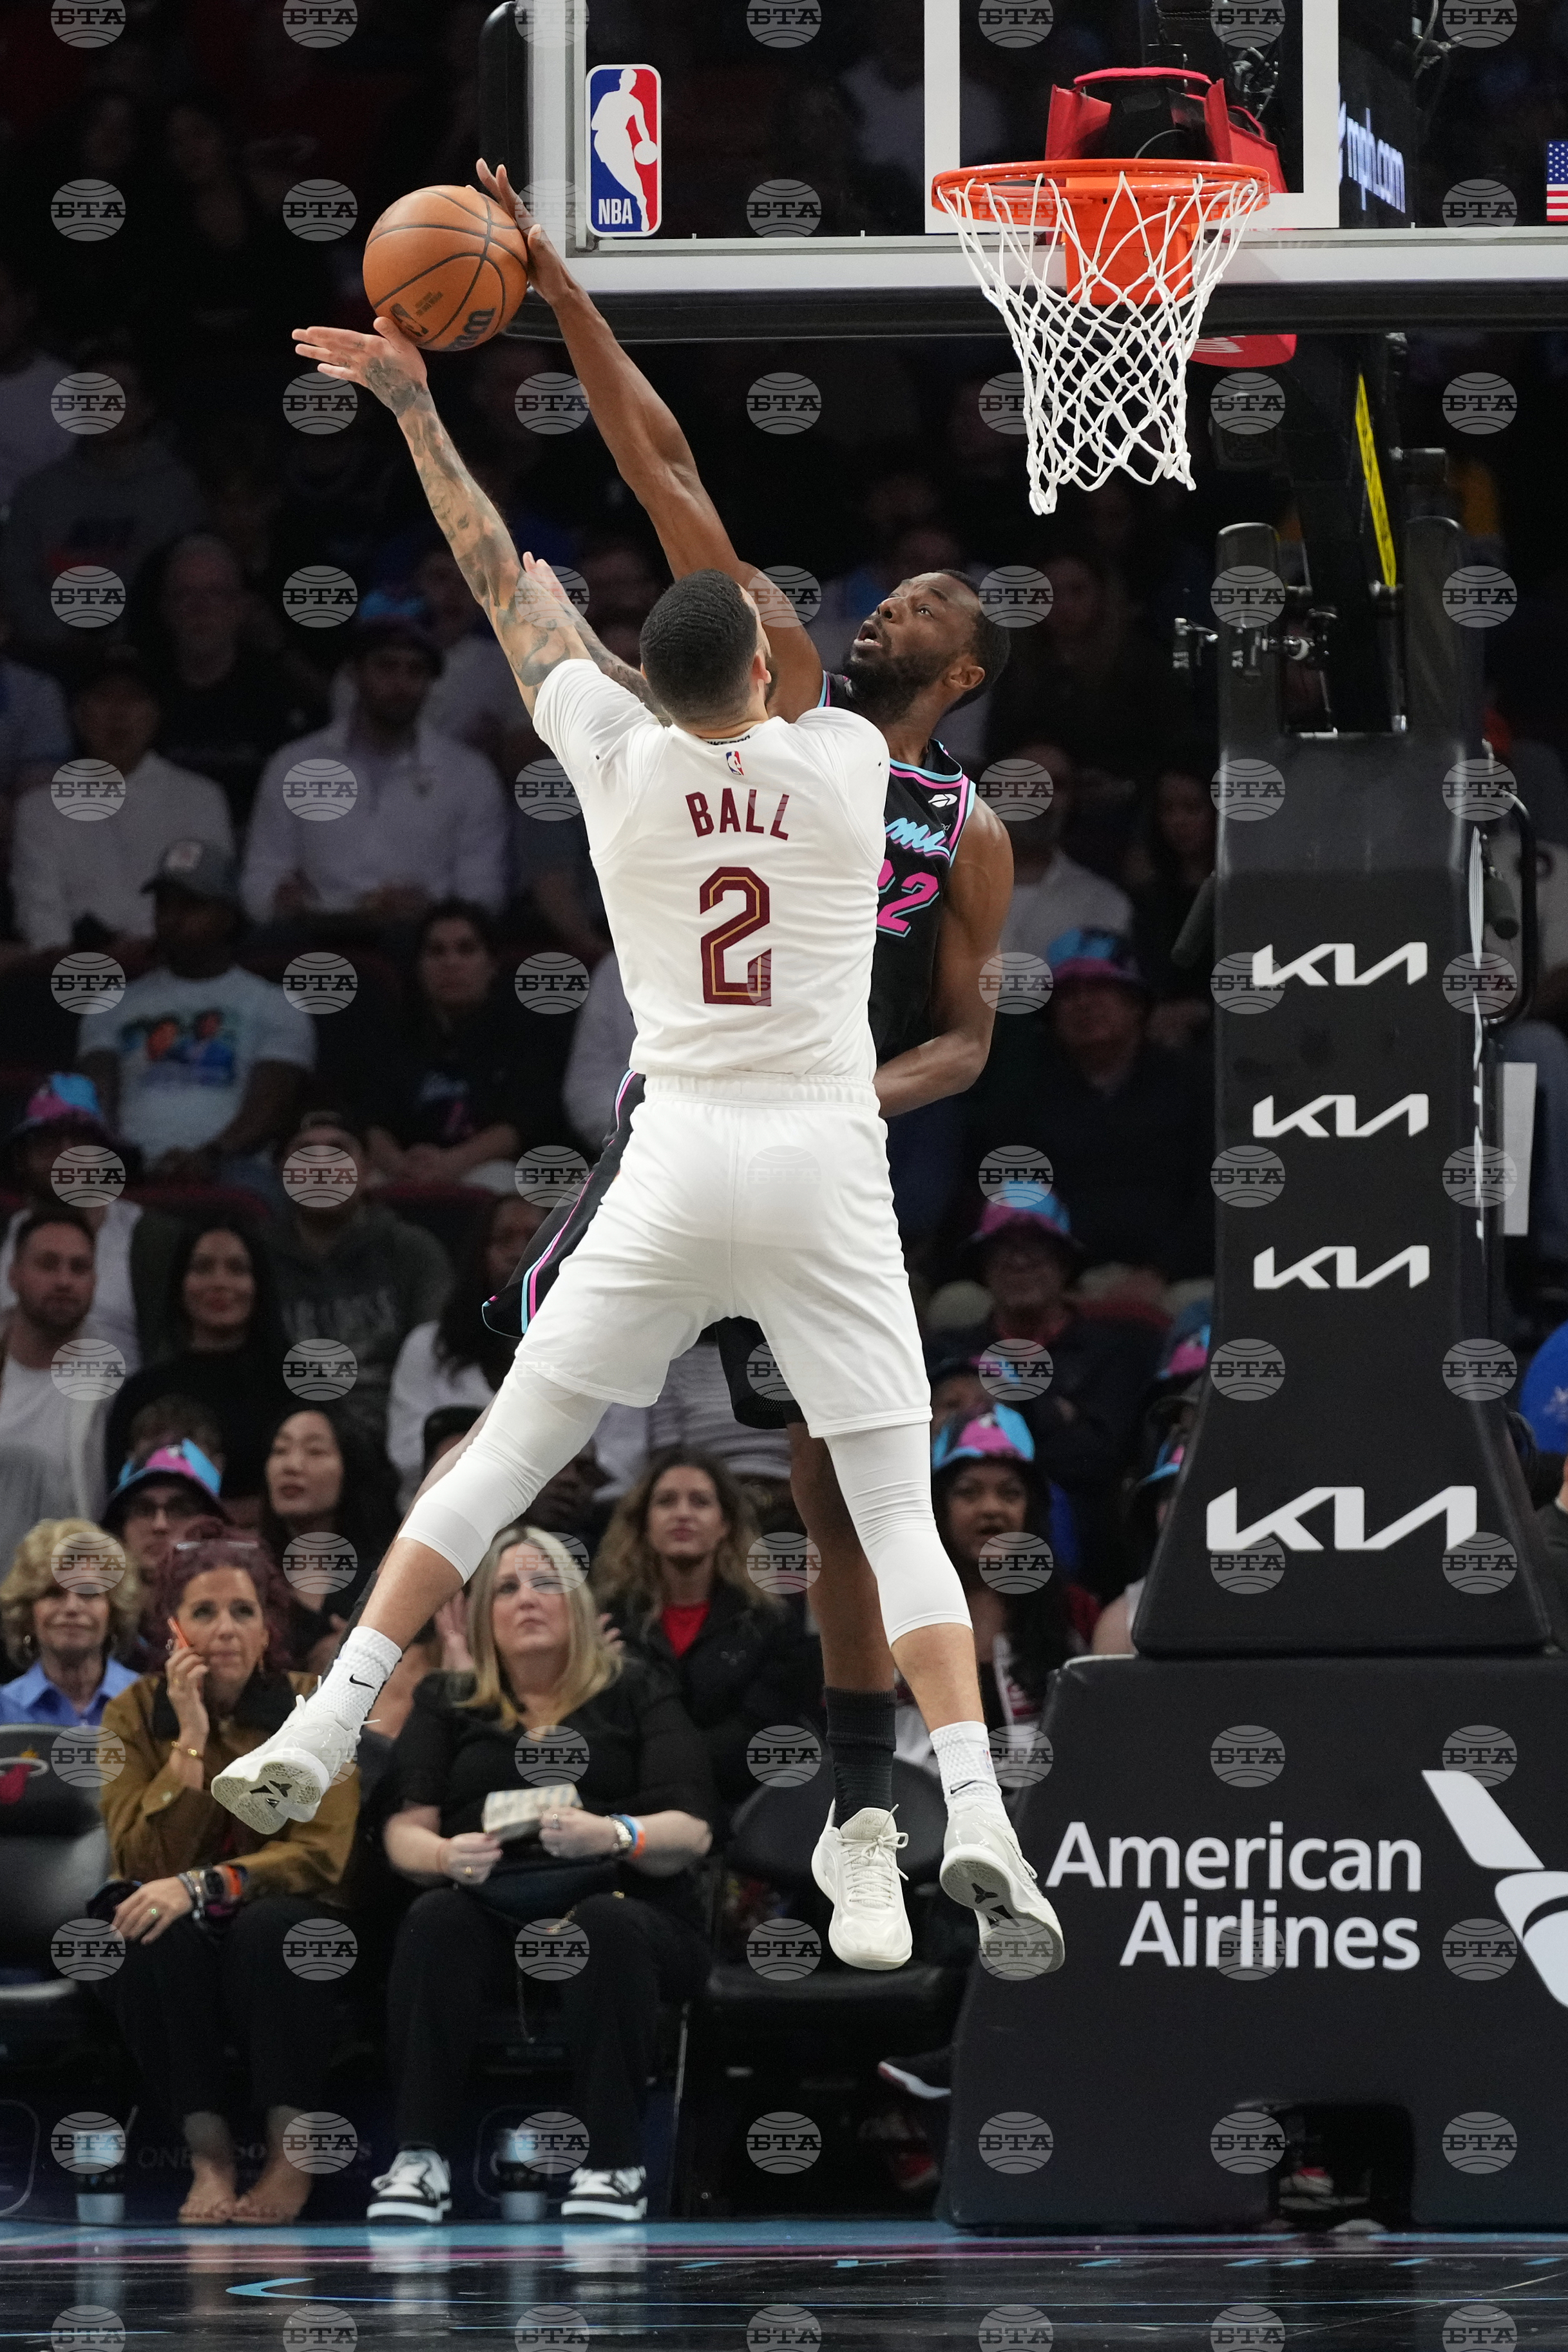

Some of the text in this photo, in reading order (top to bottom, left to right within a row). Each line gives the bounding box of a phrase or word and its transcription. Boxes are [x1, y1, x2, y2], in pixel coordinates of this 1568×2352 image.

[598, 198, 633, 225] NBA
[685, 788, 790, 841] BALL
[700, 866, 772, 1006] 2
[1045, 1821, 1422, 1892] American
[1119, 1898, 1421, 1971] Airlines
